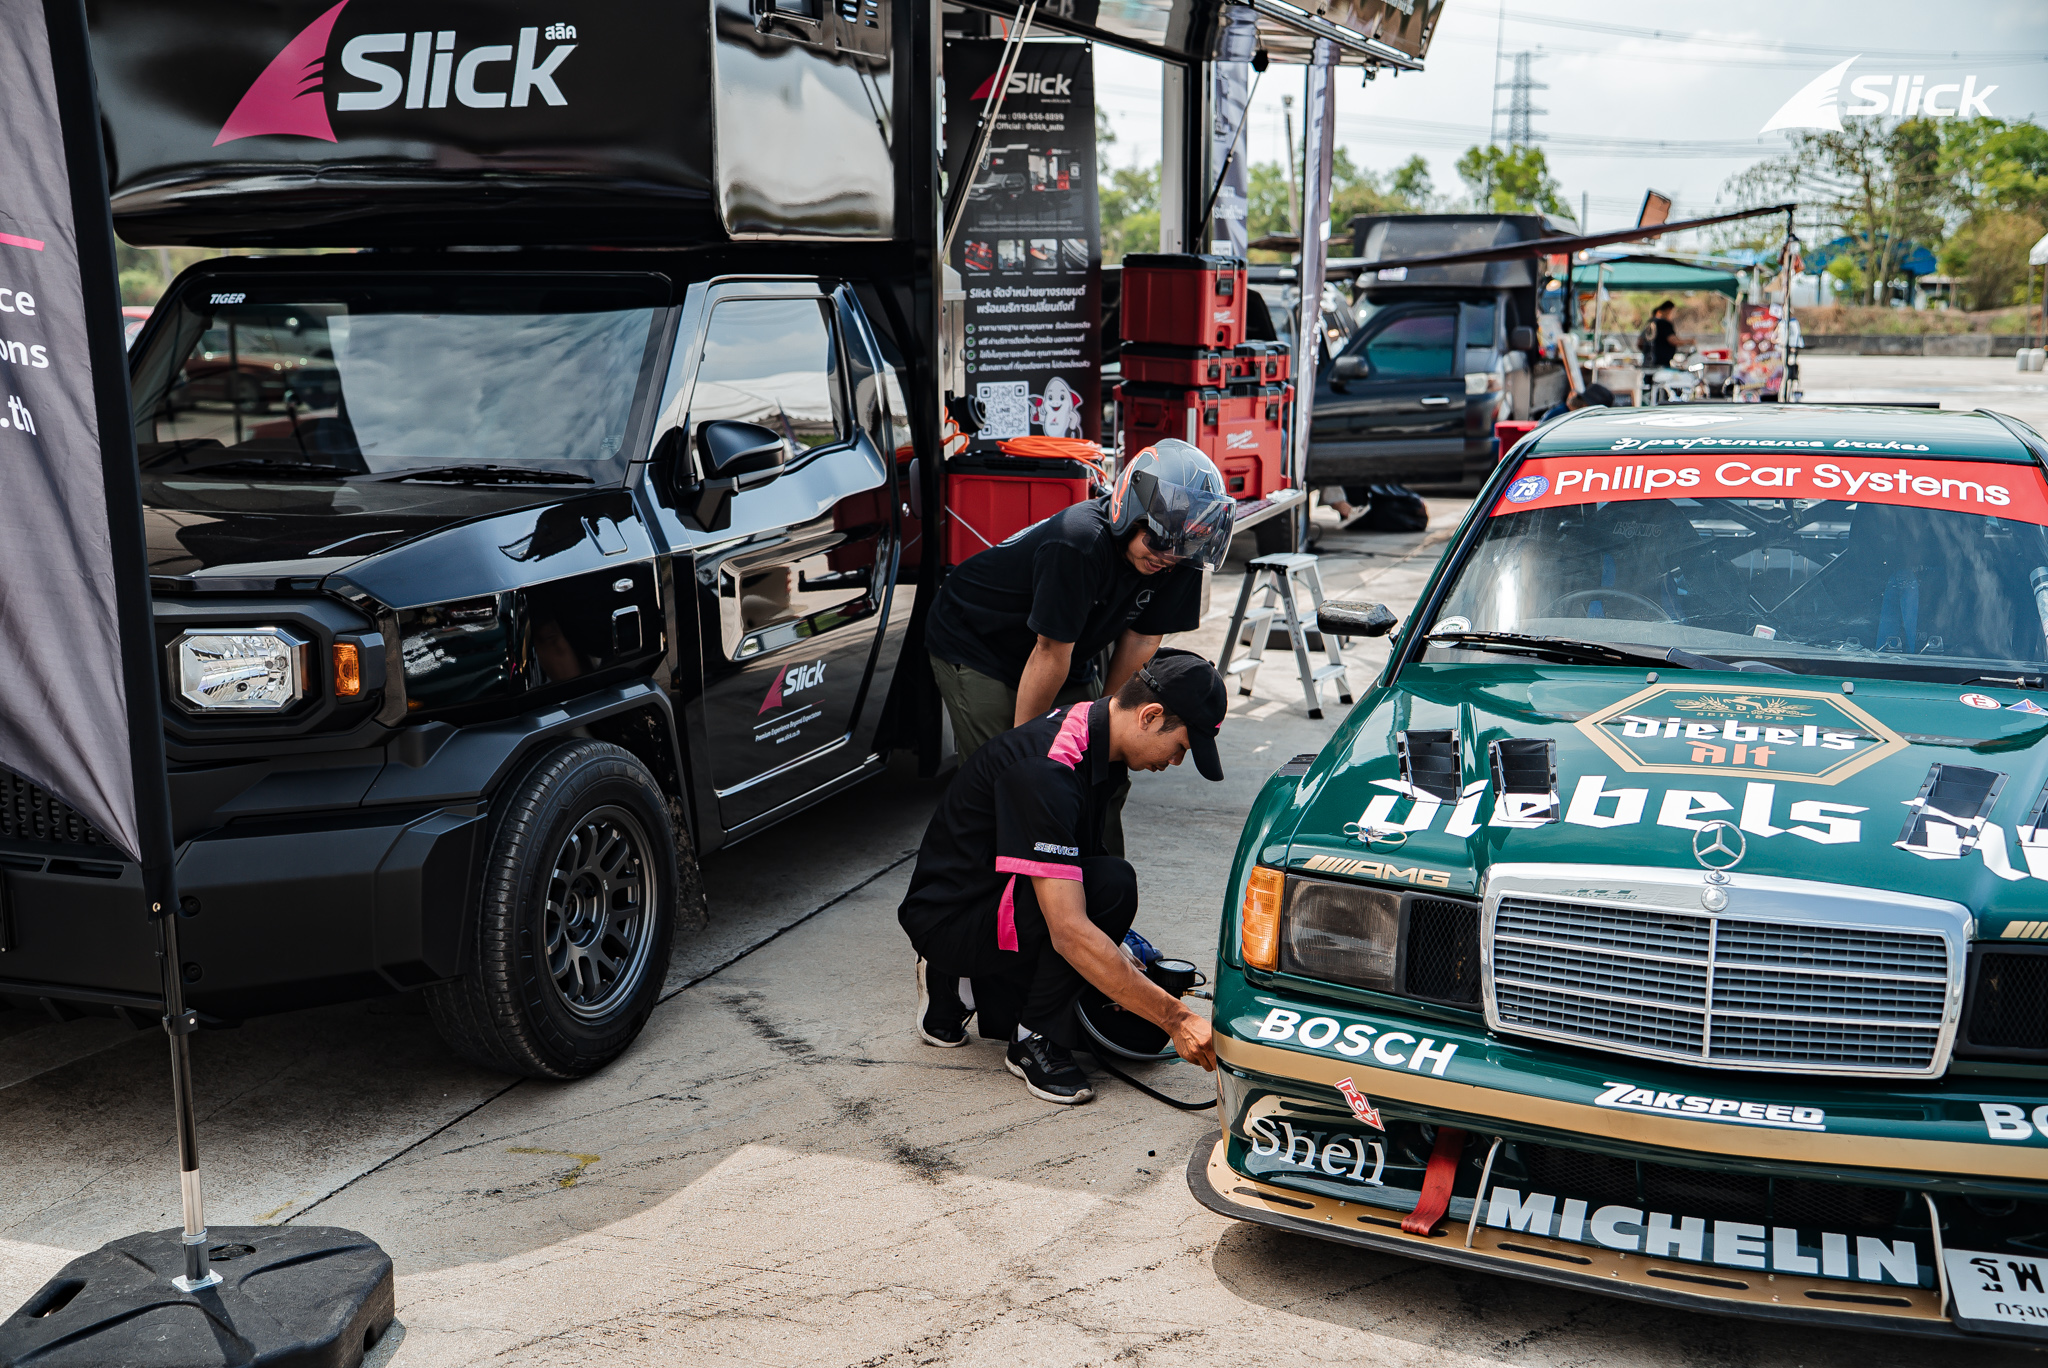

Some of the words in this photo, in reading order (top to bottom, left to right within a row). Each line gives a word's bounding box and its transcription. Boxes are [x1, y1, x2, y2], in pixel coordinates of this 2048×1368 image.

[545, 22, 577, 40] สลิค
[337, 27, 578, 111] Slick
[1007, 72, 1072, 95] Slick
[209, 292, 246, 304] TIGER
[970, 288, 992, 298] Slick
[1638, 437, 1824, 450] performance
[1833, 439, 1929, 451] brakes
[1513, 482, 1539, 497] 73
[1554, 465, 1701, 495] Philips
[1715, 461, 1801, 487] Car
[1812, 463, 2011, 506] Systems
[783, 660, 826, 697] Slick
[1033, 841, 1079, 857] SERVICE
[1256, 1007, 1459, 1077] BOSCH
[1345, 1089, 1375, 1121] TOW
[1594, 1081, 1826, 1131] ZAKSPEED
[1250, 1115, 1386, 1186] Shell
[1486, 1186, 1919, 1285] MICHELIN
